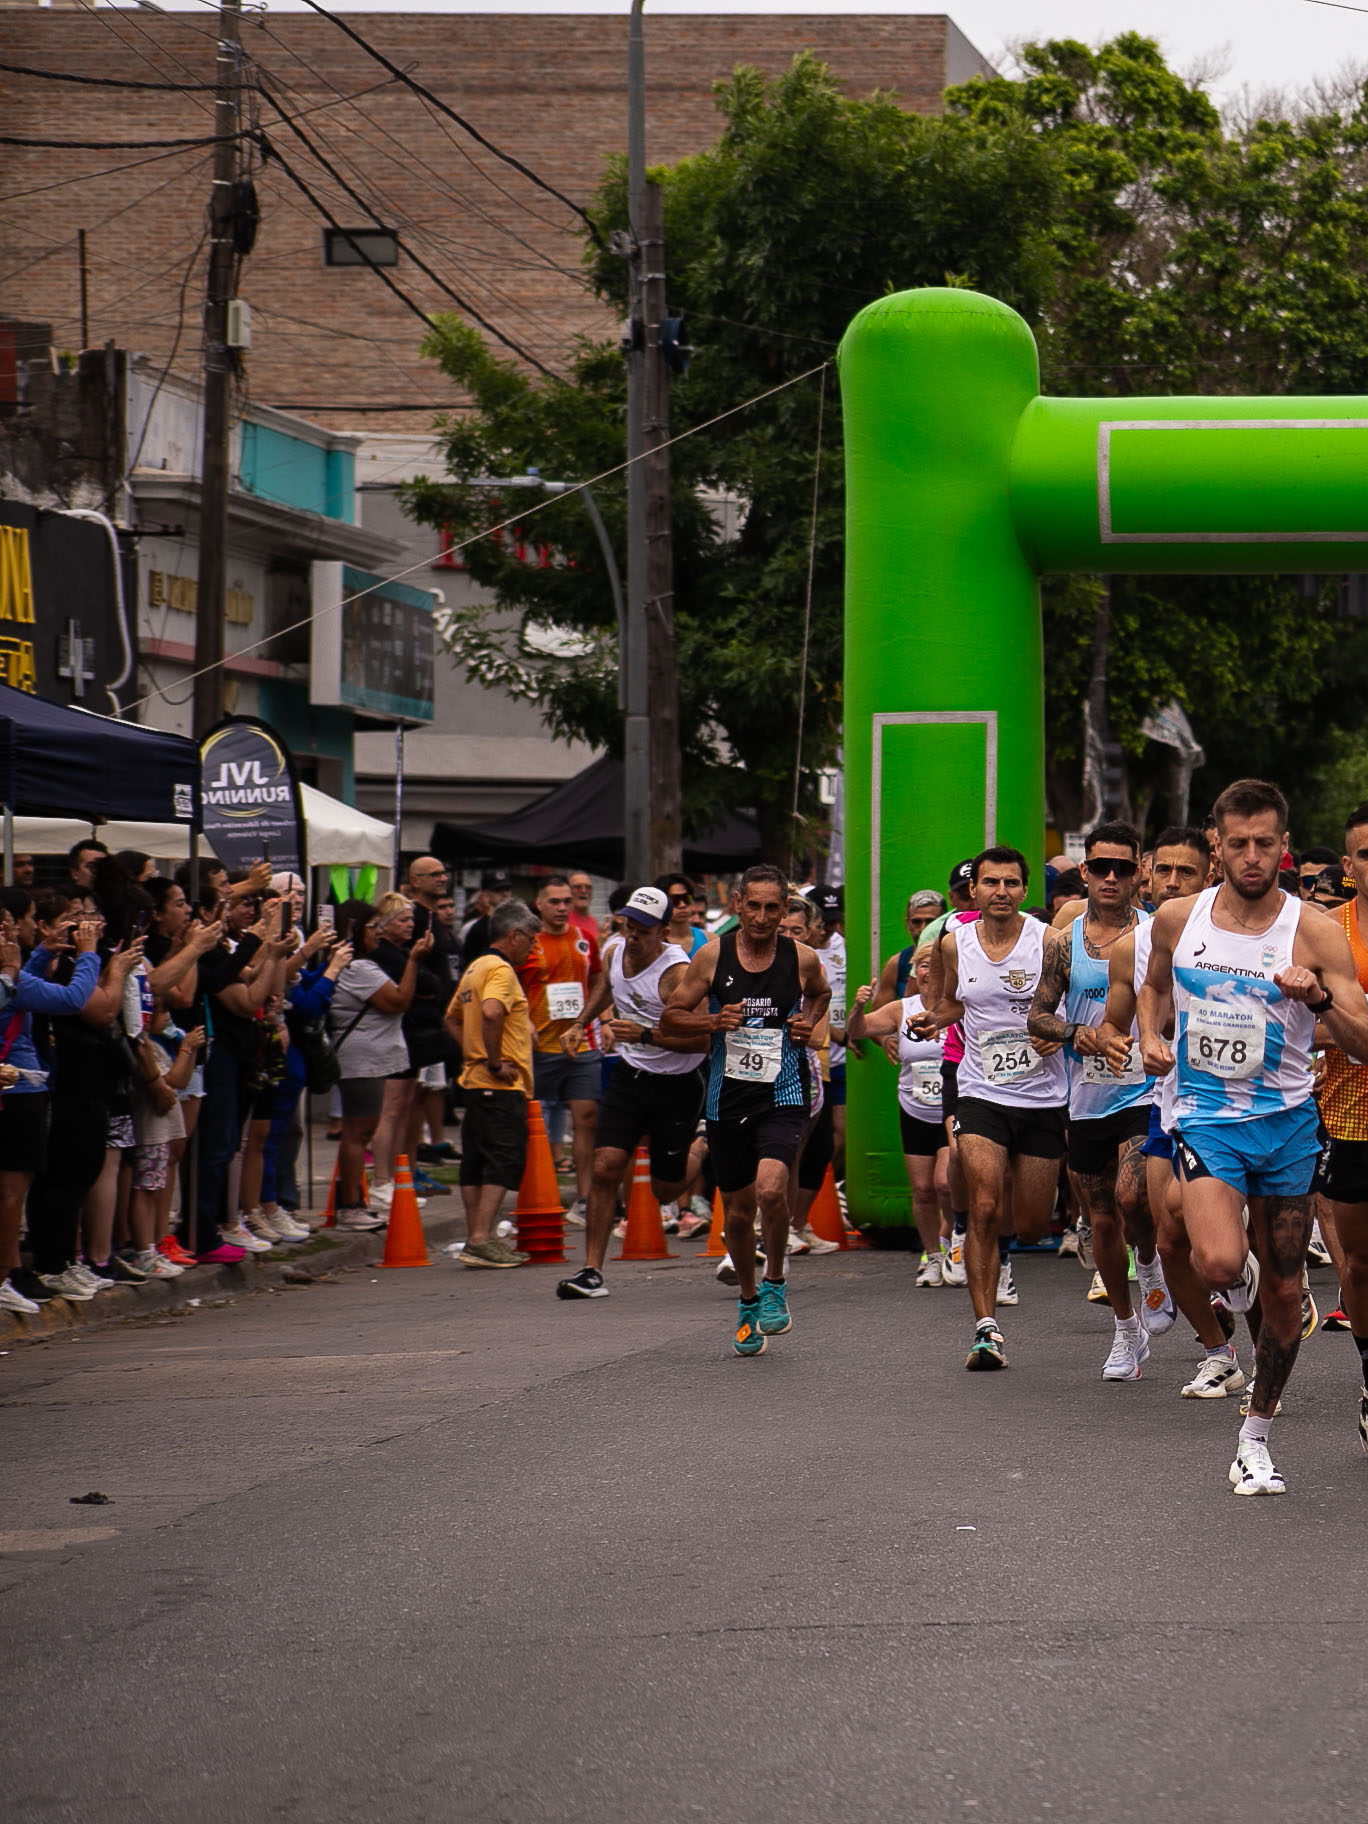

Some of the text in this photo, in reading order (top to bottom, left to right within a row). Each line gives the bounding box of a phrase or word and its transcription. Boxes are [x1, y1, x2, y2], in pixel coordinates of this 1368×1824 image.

[1194, 961, 1266, 980] ARGENTINA
[1084, 987, 1106, 1000] TODO
[556, 999, 580, 1013] 336
[1198, 1008, 1254, 1021] 40 MARATON
[1198, 1035, 1248, 1065] 678
[739, 1052, 764, 1072] 49
[992, 1049, 1032, 1073] 254
[1093, 1052, 1134, 1073] 52
[921, 1080, 943, 1096] 56
